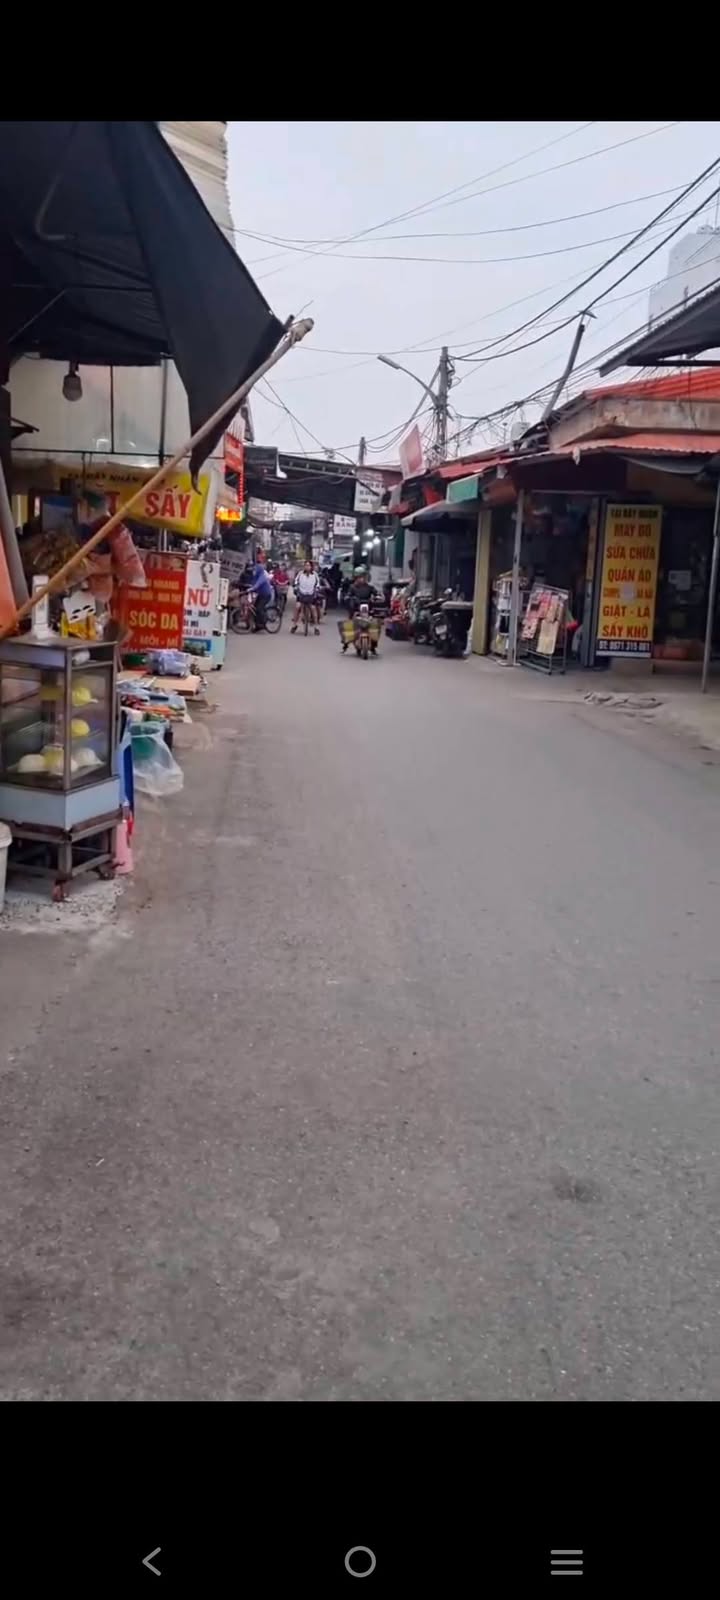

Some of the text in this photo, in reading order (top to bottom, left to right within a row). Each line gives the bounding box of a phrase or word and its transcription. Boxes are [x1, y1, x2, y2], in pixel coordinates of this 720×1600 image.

[145, 484, 191, 519] SẤY
[187, 584, 213, 607] NỮ
[129, 608, 178, 630] SÓC DA
[602, 604, 627, 620] GIẶT
[602, 621, 649, 638] SẤY KHÔ
